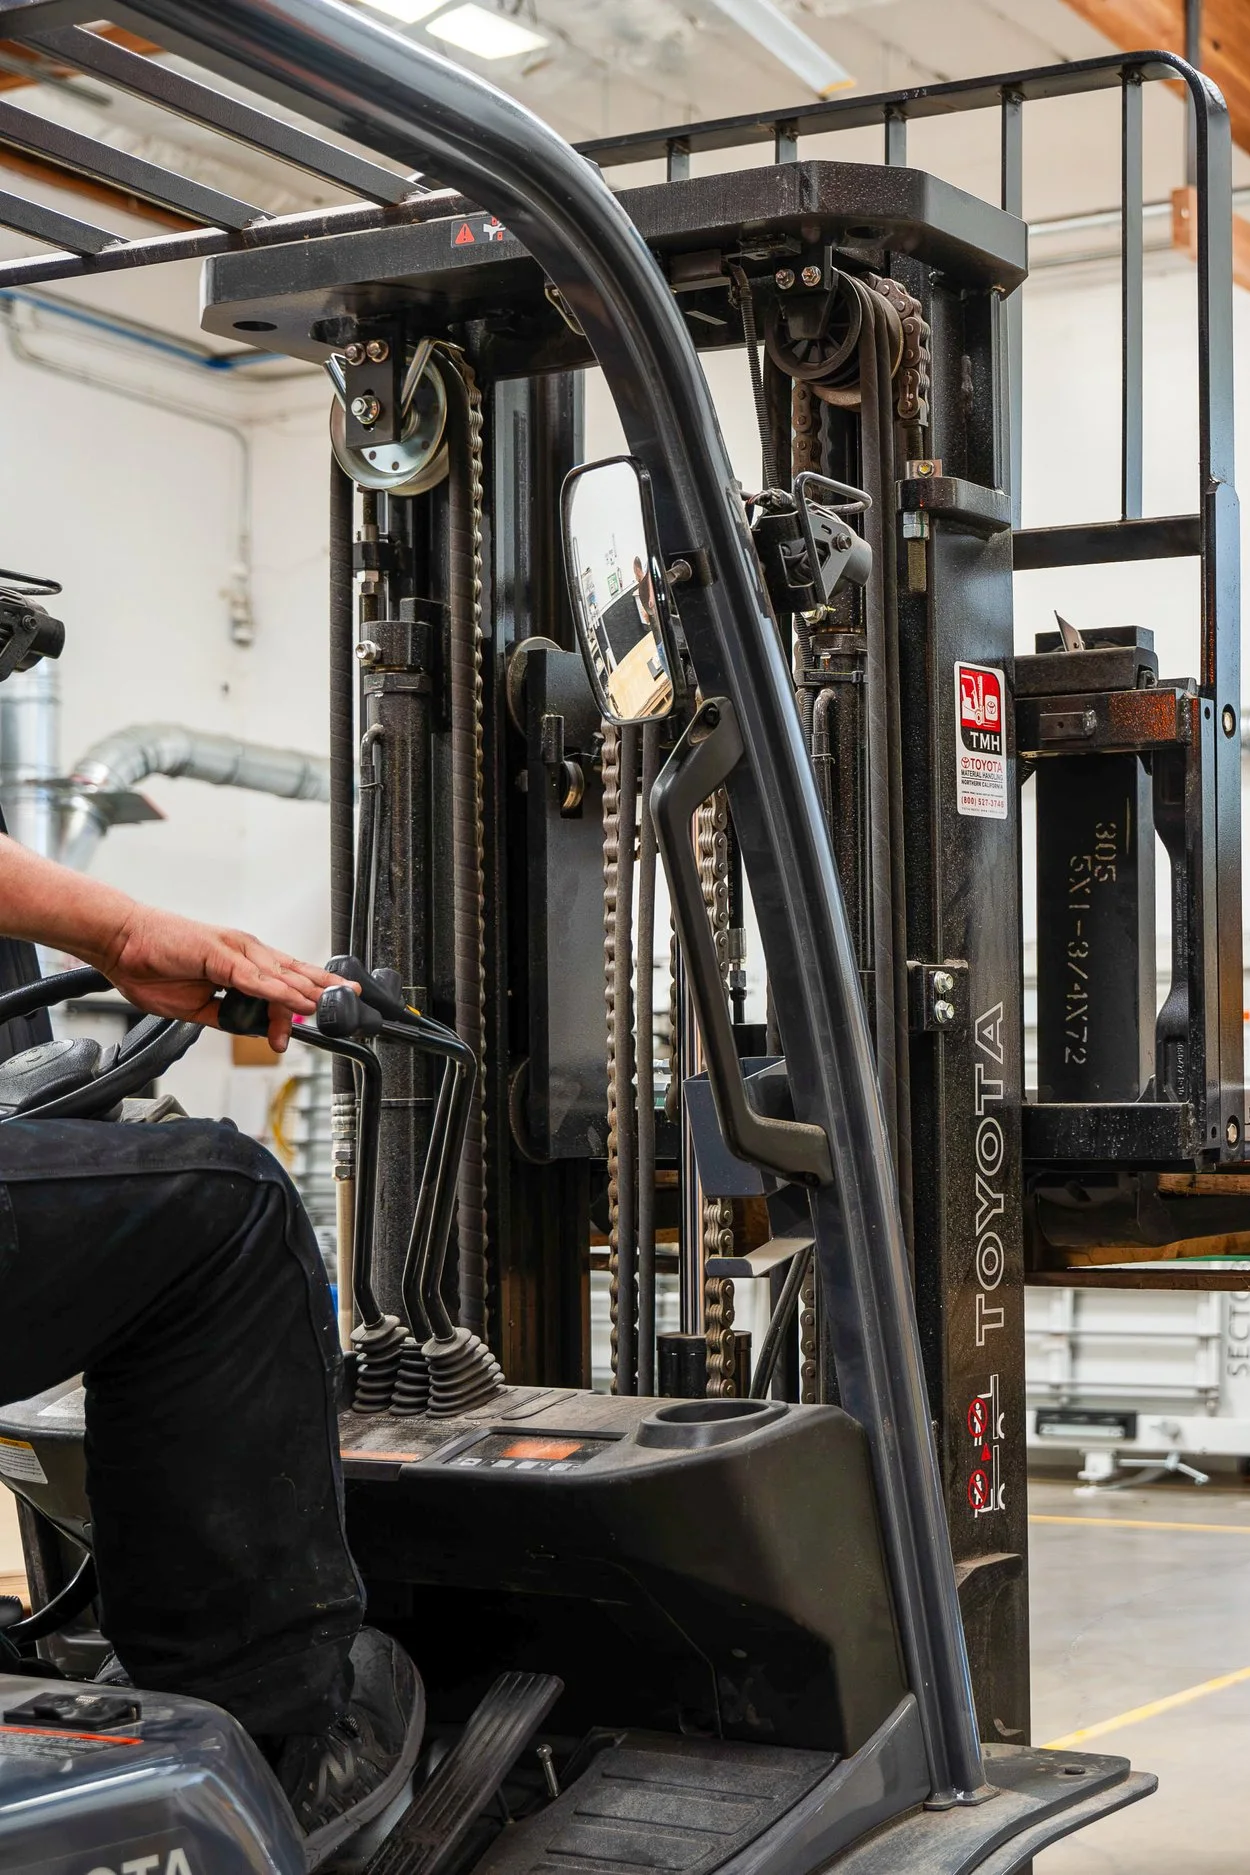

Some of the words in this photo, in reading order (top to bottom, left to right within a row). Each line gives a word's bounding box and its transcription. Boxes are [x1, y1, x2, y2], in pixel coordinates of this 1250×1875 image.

[969, 731, 1001, 752] TMH
[961, 769, 982, 779] MATERIAL
[970, 757, 1003, 773] TOYOTA
[961, 780, 982, 788] NORTHERN
[1094, 823, 1117, 882] 305
[975, 1001, 1005, 1347] TOYOTA
